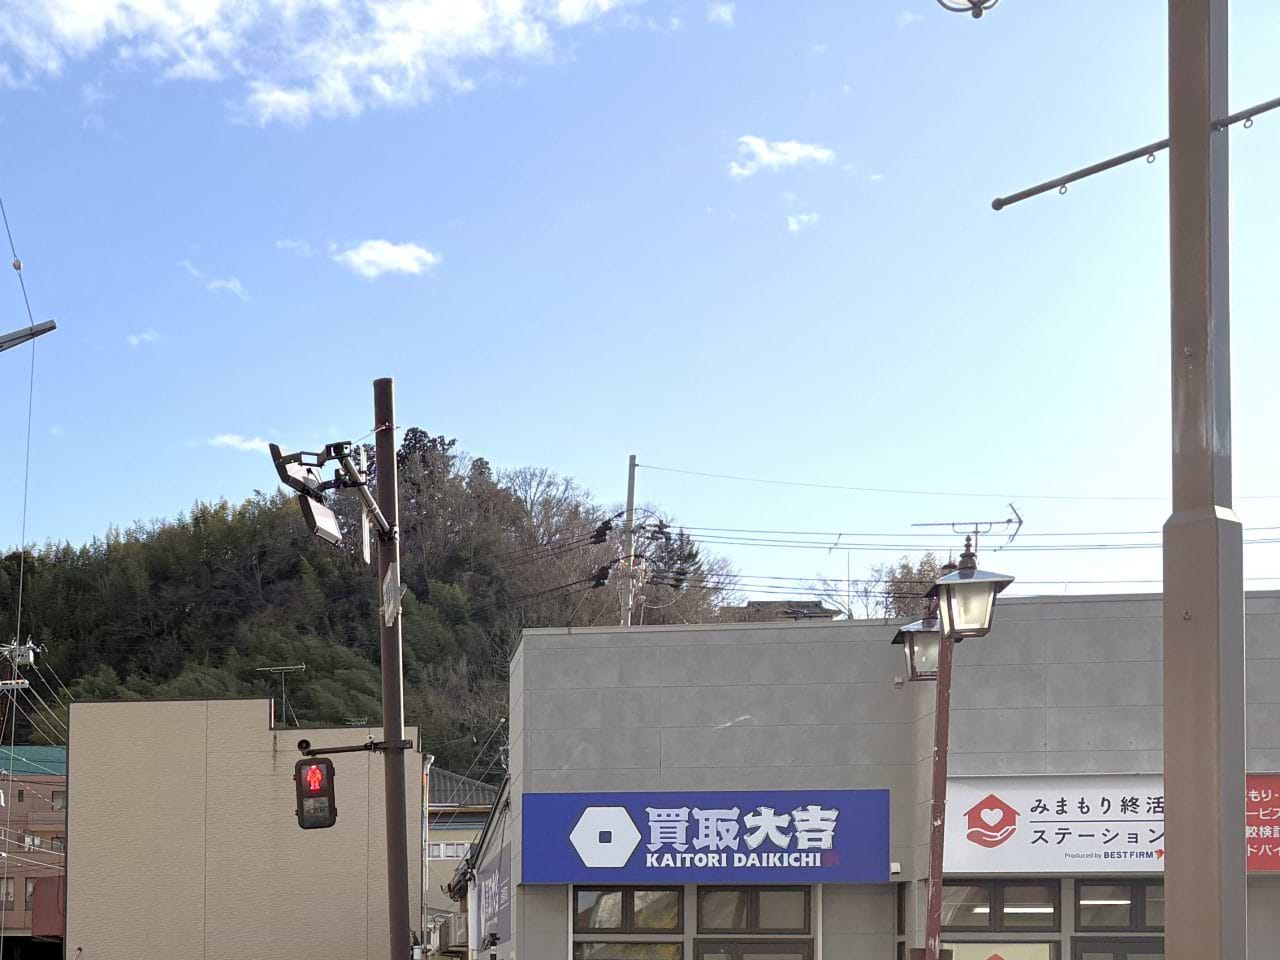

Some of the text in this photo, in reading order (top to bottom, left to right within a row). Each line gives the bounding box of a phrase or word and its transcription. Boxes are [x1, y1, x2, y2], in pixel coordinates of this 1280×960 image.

[1245, 789, 1280, 802] もり・
[1030, 796, 1164, 816] みまもり終活
[644, 804, 840, 852] 買取大吉
[1030, 827, 1164, 845] ステーション
[645, 852, 822, 868] KAITORI DAIKICHI
[1064, 851, 1154, 860] Produced by BEST FIRM
